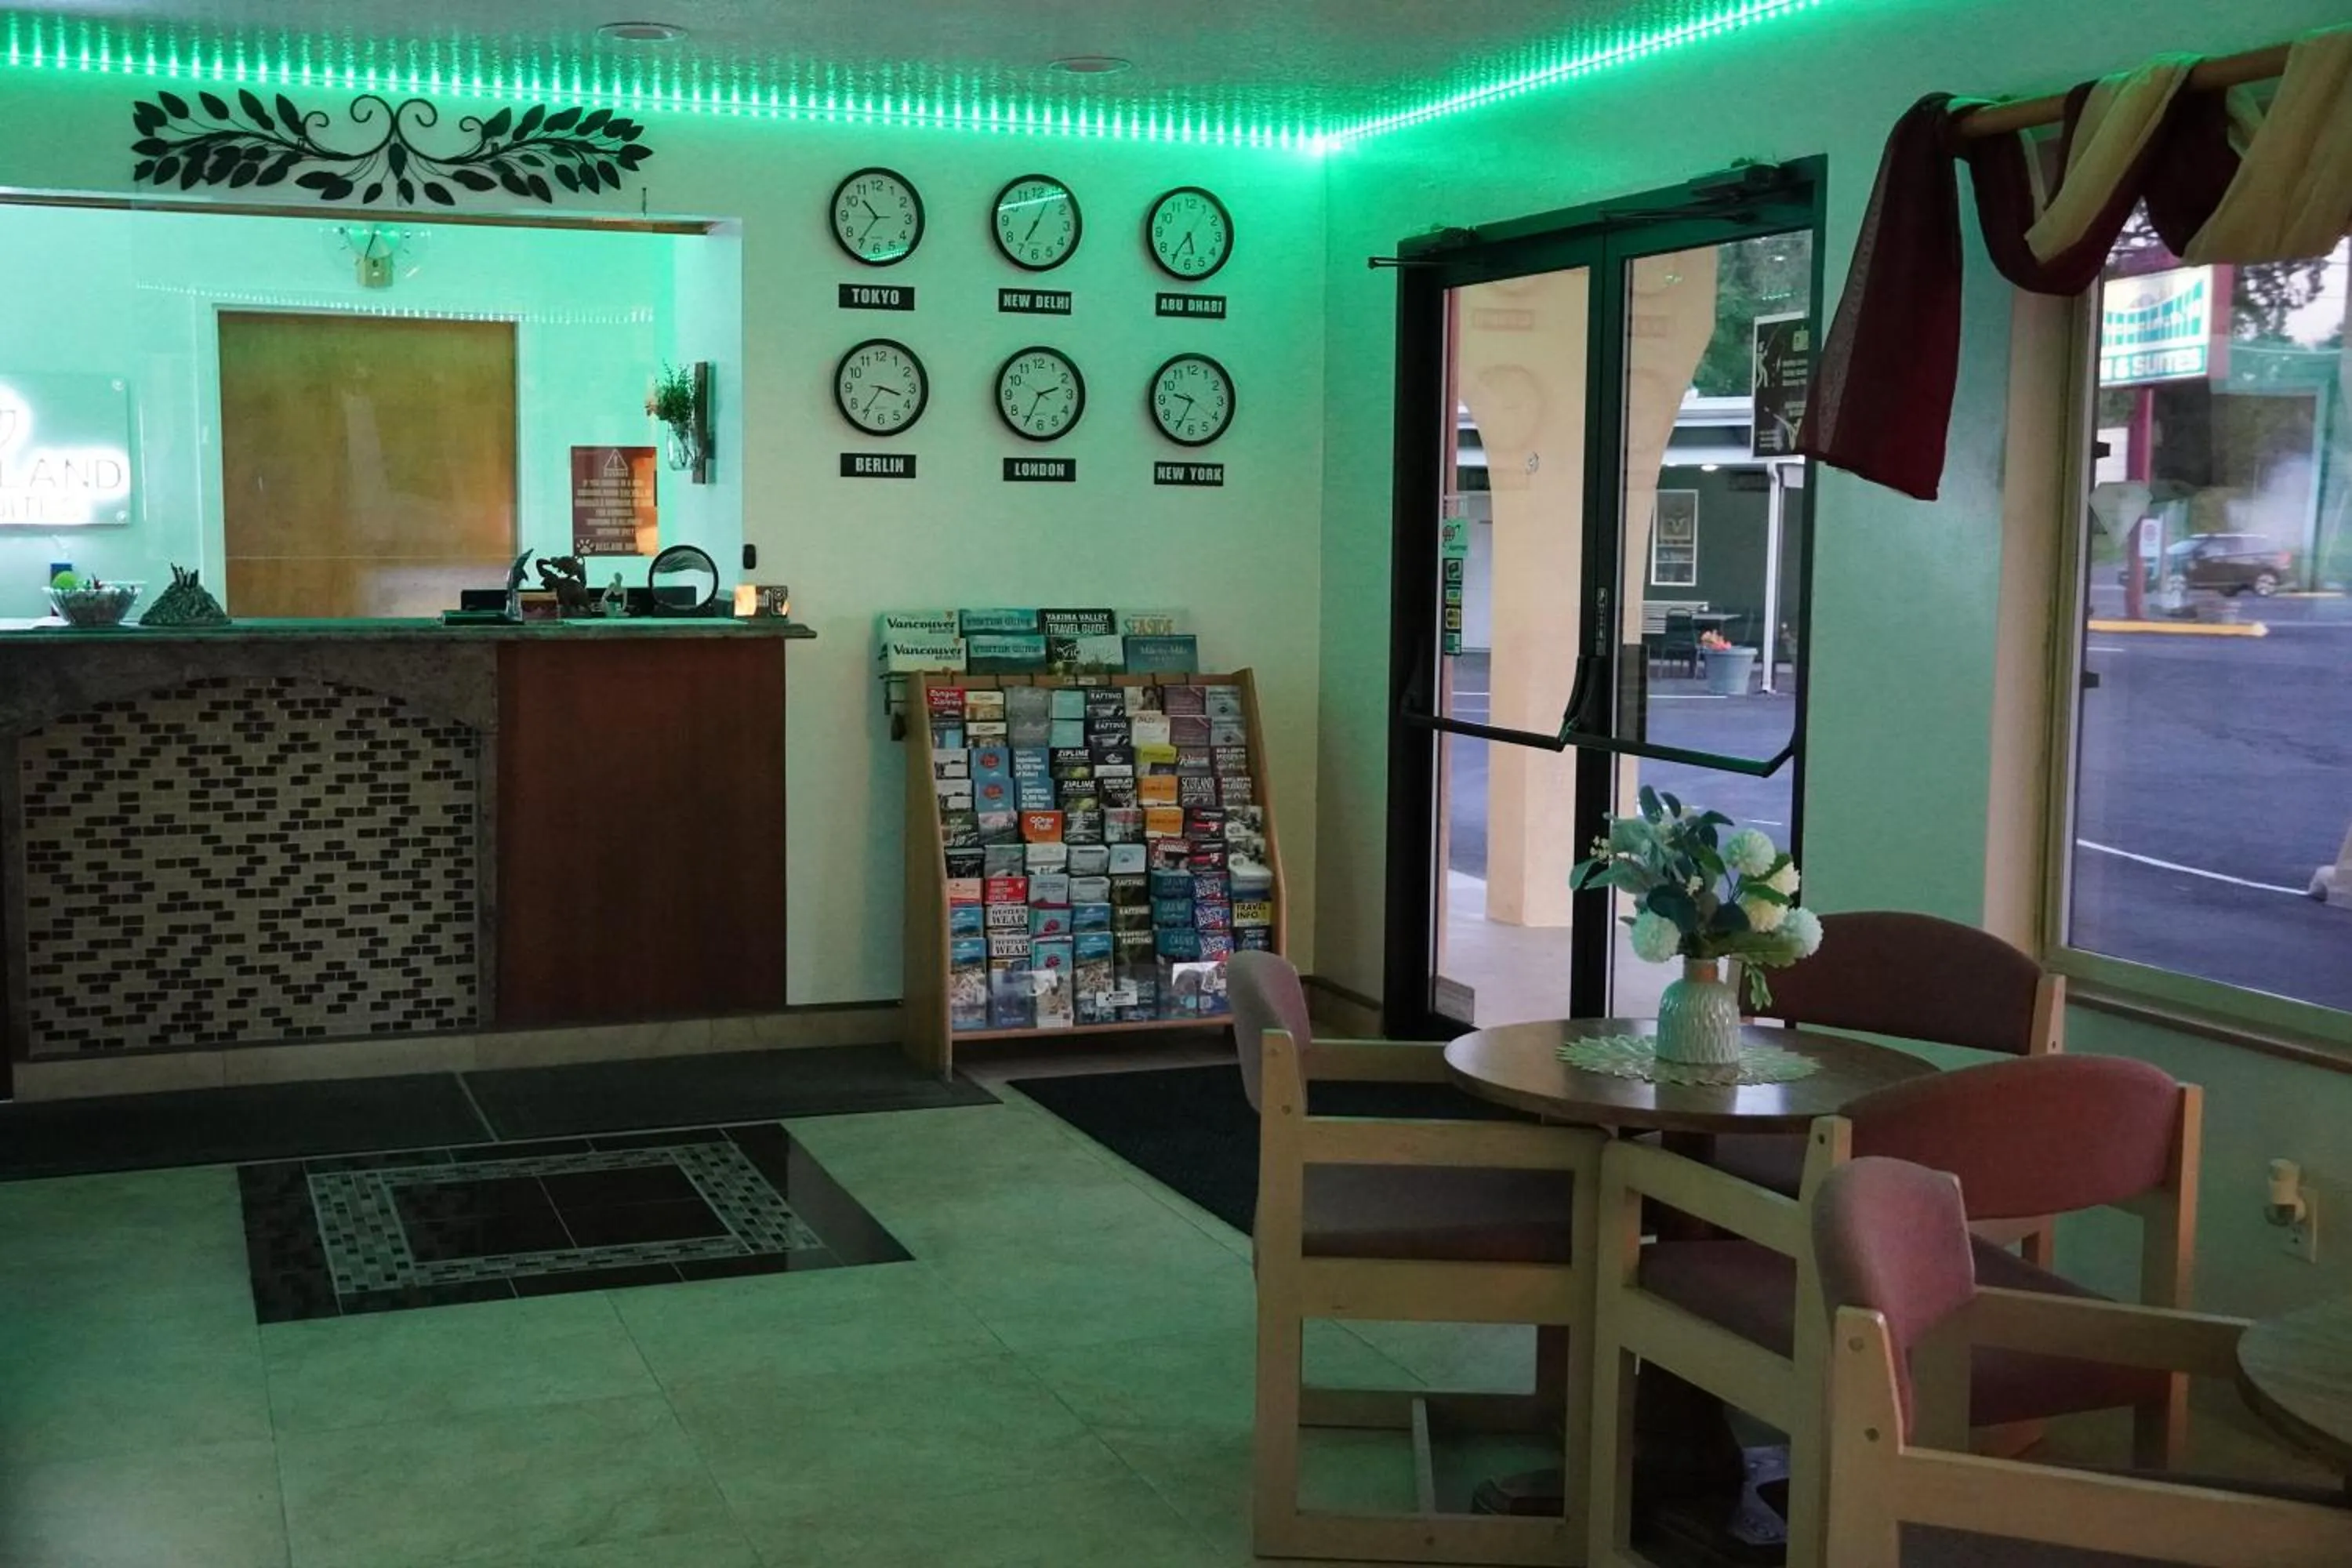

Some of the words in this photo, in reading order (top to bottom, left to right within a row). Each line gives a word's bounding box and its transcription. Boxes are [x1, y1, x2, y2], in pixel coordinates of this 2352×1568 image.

[856, 184, 866, 195] 11
[871, 180, 884, 191] 12
[846, 195, 858, 207] 10
[899, 197, 907, 209] 2
[1185, 198, 1197, 209] 12
[1058, 205, 1066, 215] 2
[1172, 201, 1180, 213] 11
[840, 209, 849, 222] 9
[904, 213, 913, 225] 3
[1002, 215, 1009, 226] 9
[1161, 212, 1172, 224] 10
[1210, 215, 1218, 227] 2
[847, 226, 854, 238] 8
[1063, 221, 1070, 232] 3
[1156, 226, 1163, 238] 9
[900, 230, 906, 240] 4
[1006, 230, 1014, 243] 8
[1214, 231, 1221, 242] 3
[888, 241, 896, 251] 5
[1057, 236, 1065, 246] 4
[873, 243, 880, 254] 6
[1018, 243, 1024, 255] 7
[1045, 246, 1053, 257] 5
[1160, 241, 1167, 253] 8
[1209, 247, 1216, 257] 4
[1031, 249, 1039, 260] 6
[1184, 259, 1190, 270] 6
[1198, 256, 1205, 267] 5
[851, 288, 900, 305] TOKYO
[1004, 293, 1031, 307] NEW
[1036, 296, 1069, 310] DELHI
[1161, 298, 1183, 311] ABU
[1188, 299, 1222, 313] DHABI
[861, 355, 869, 366] 11
[874, 351, 887, 361] 12
[1019, 363, 1029, 373] 11
[1032, 358, 1045, 368] 12
[850, 366, 862, 379] 10
[903, 366, 911, 377] 2
[1173, 369, 1182, 379] 11
[1187, 365, 1199, 376] 12
[1009, 375, 1021, 387] 10
[1061, 372, 1068, 383] 2
[845, 382, 853, 393] 9
[909, 383, 916, 394] 3
[1164, 380, 1174, 391] 10
[1212, 380, 1219, 391] 2
[1004, 389, 1012, 401] 9
[1066, 388, 1073, 400] 3
[1159, 394, 1166, 405] 9
[851, 397, 858, 410] 8
[903, 398, 910, 409] 4
[1217, 395, 1224, 407] 3
[893, 410, 900, 420] 5
[1011, 405, 1018, 416] 8
[1061, 405, 1069, 415] 4
[1163, 409, 1171, 421] 8
[878, 414, 884, 425] 6
[1051, 415, 1058, 426] 5
[1211, 411, 1218, 422] 4
[1036, 419, 1044, 431] 6
[1188, 424, 1194, 436] 6
[1202, 421, 1208, 432] 5
[855, 457, 904, 473] BERLIN
[1014, 462, 1065, 477] LONDON
[1157, 466, 1185, 480] NEW
[1189, 467, 1222, 481] YORK
[887, 618, 956, 629] Vancouver
[1046, 614, 1077, 622] YAKIMA
[1079, 614, 1109, 622] VALLEY
[1049, 624, 1080, 634] TRAVEL
[1081, 624, 1107, 634] GUIDE
[893, 644, 964, 655] Vancouver
[1063, 780, 1095, 789] ZIPLINE
[993, 915, 1025, 924] WEAR
[996, 945, 1029, 953] WEAR
